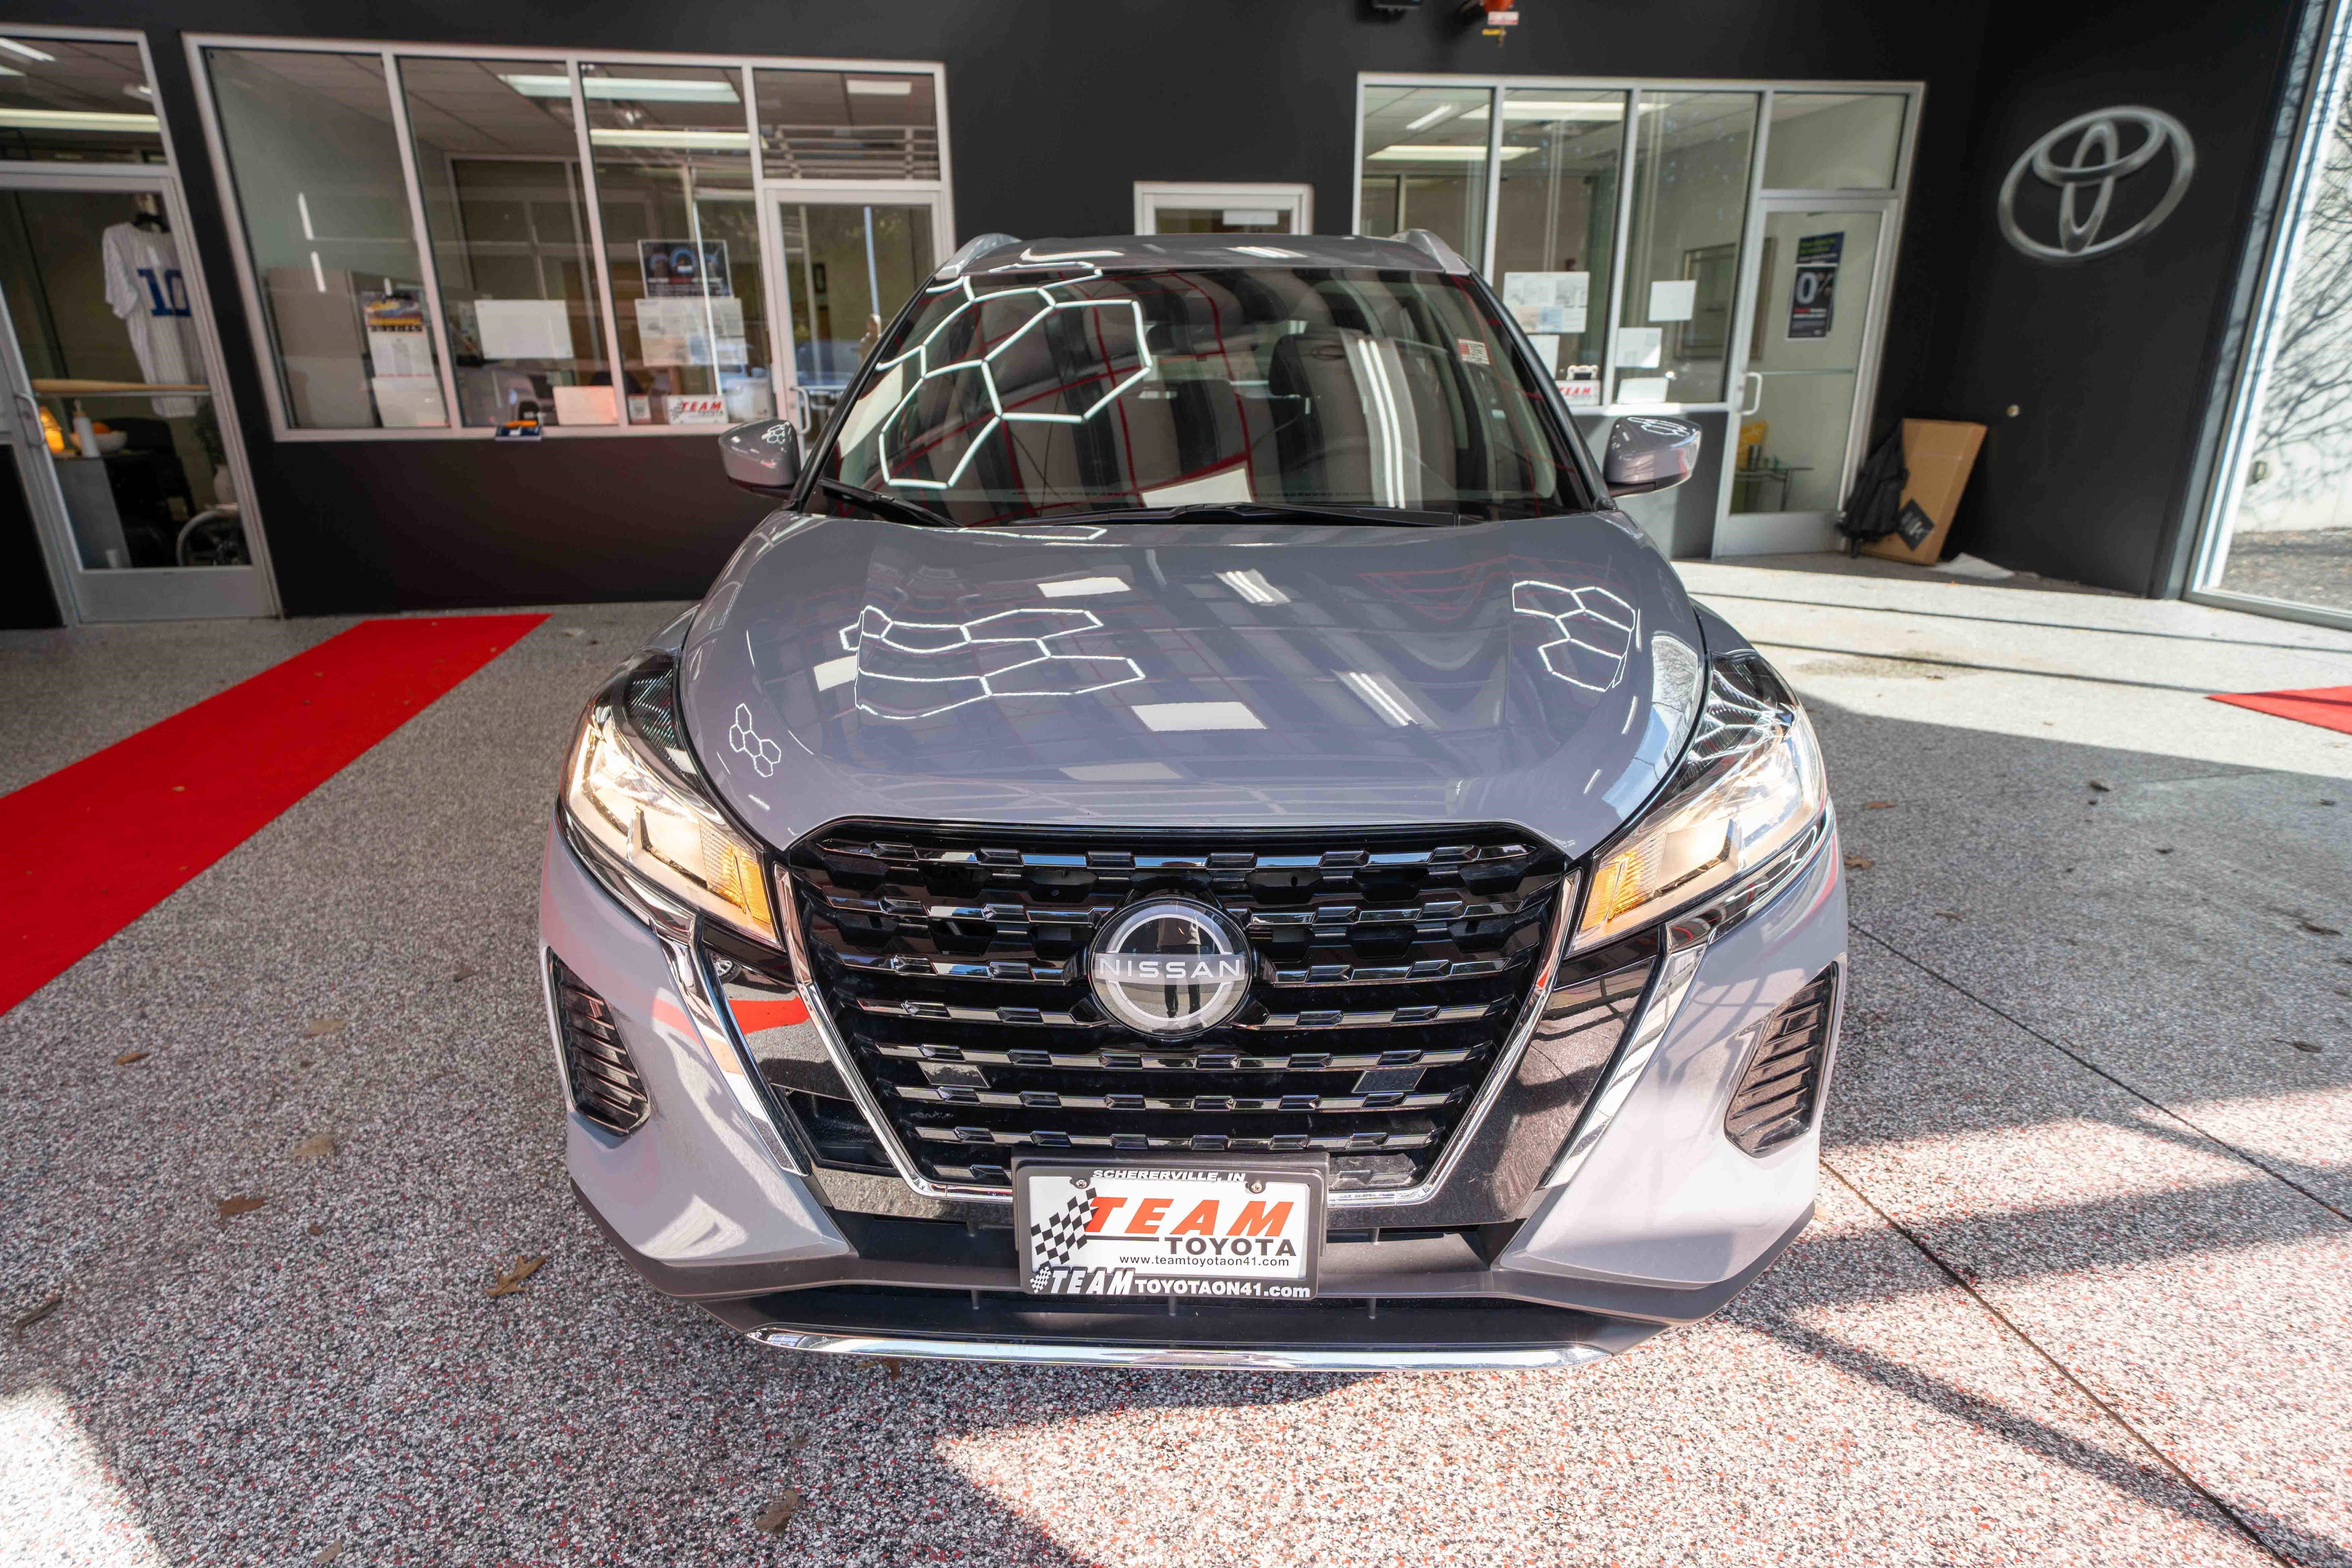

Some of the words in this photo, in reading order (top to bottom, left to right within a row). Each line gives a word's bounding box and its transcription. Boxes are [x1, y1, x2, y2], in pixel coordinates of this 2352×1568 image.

[682, 401, 722, 412] TEAM
[1100, 958, 1239, 978] NISSAN
[1227, 1172, 1246, 1181] IN
[1084, 1196, 1294, 1236] TEAM
[1165, 1236, 1296, 1256] TOYOTA
[1119, 1255, 1289, 1267] www.teamtoyotaon41.com
[1050, 1268, 1136, 1295] TEAM
[1134, 1278, 1310, 1298] TOYOTAON41.com
